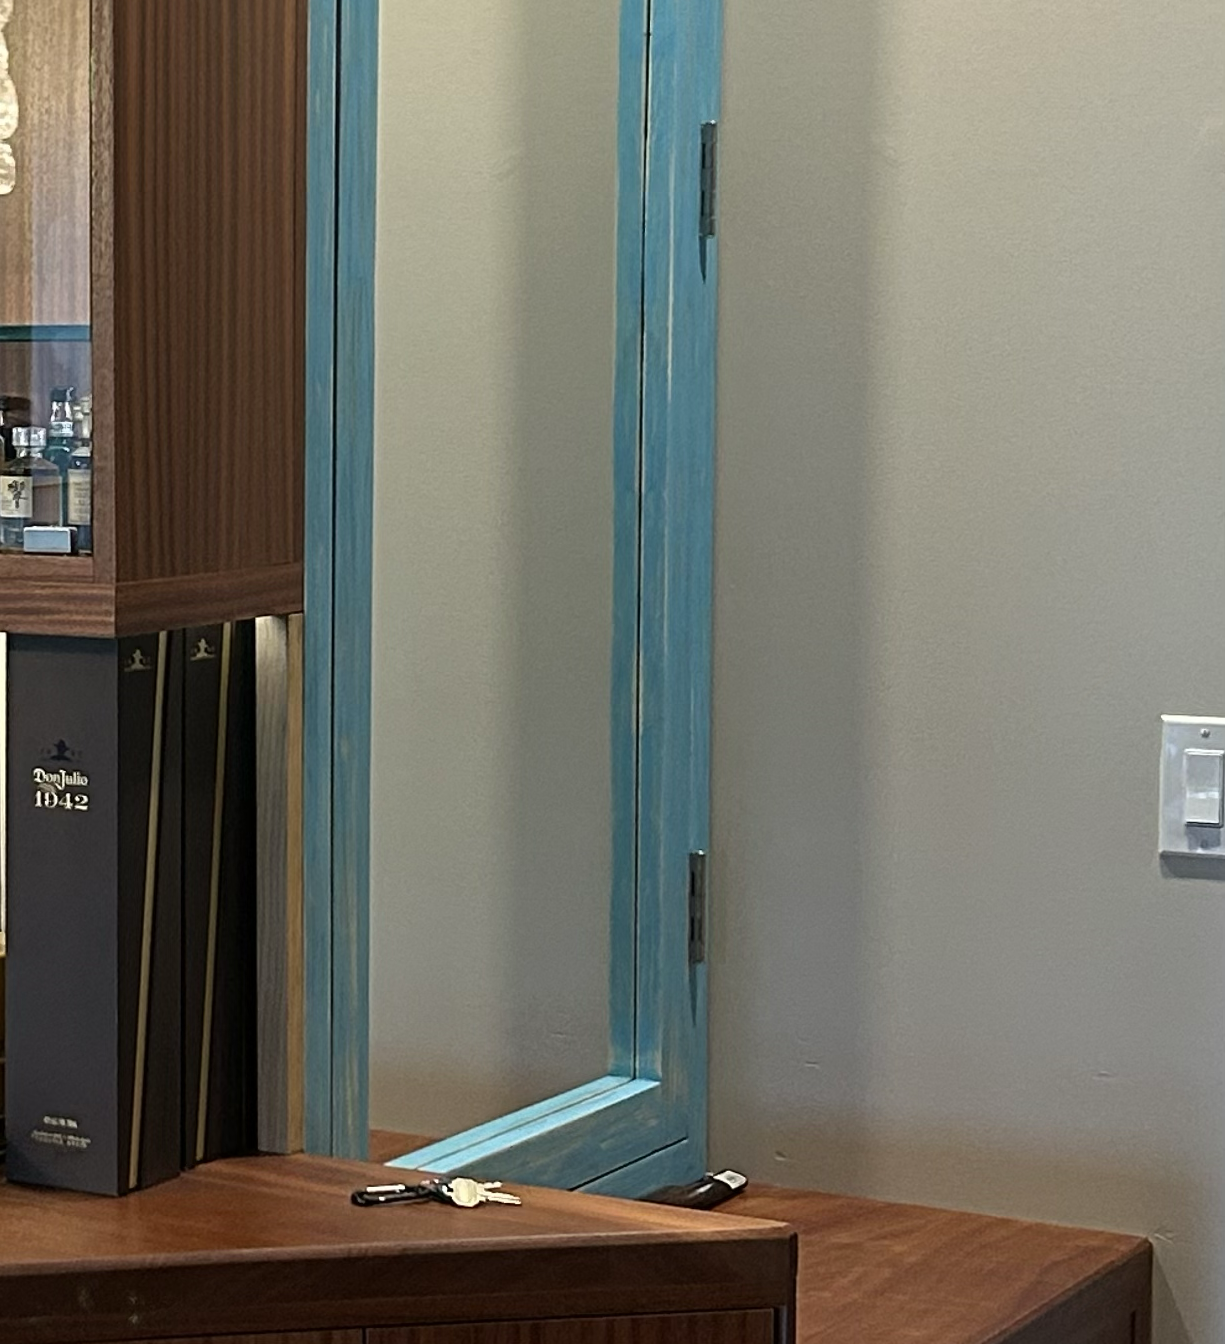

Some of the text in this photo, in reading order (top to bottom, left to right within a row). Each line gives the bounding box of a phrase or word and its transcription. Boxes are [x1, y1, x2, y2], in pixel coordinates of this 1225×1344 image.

[33, 767, 89, 791] Don Julio
[34, 790, 89, 811] 1942
